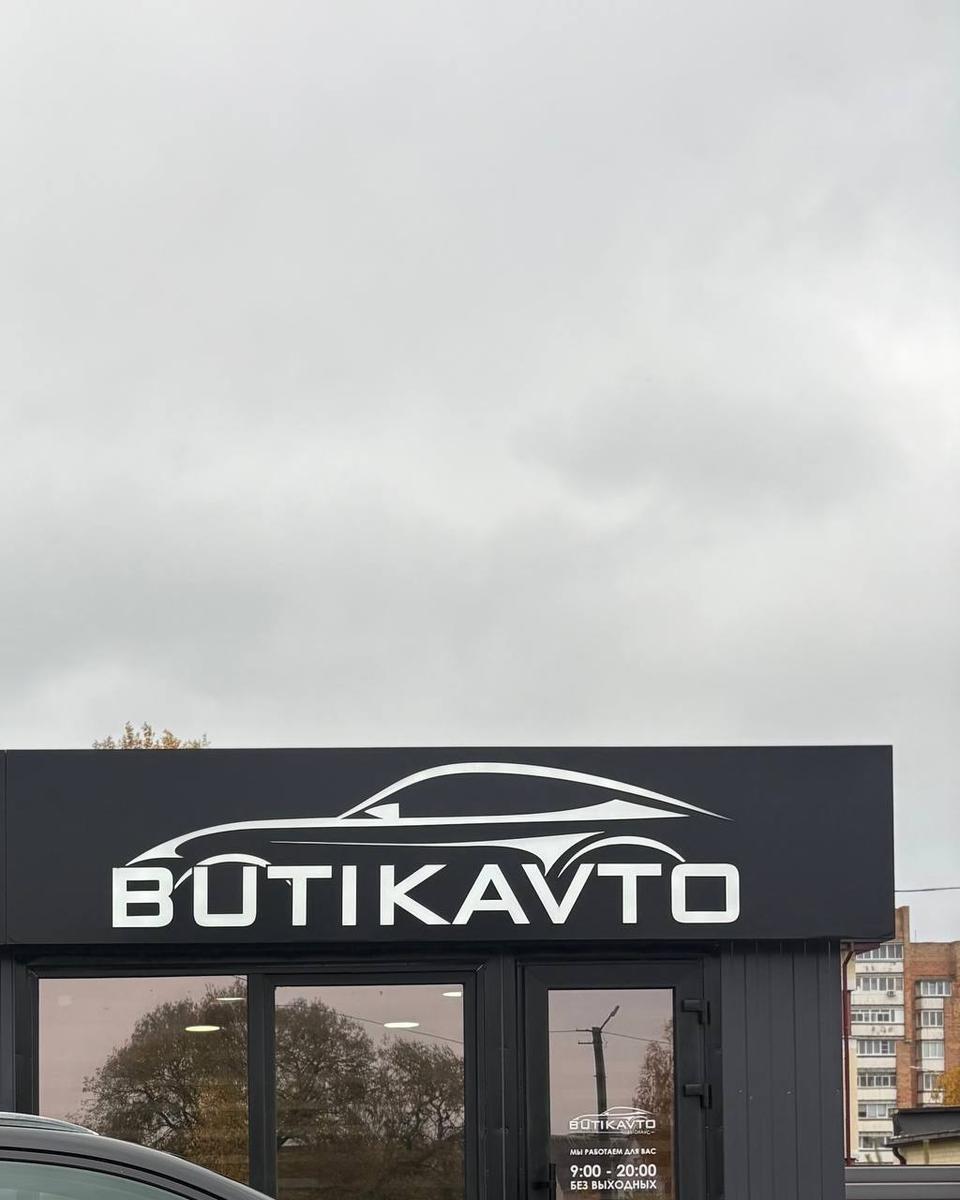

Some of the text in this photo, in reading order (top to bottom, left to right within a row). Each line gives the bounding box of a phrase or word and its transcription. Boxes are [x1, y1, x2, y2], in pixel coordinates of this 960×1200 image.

[112, 863, 740, 928] BUTIKAVTO
[569, 1119, 656, 1130] BUTIKAVTO
[570, 1147, 657, 1156] МЫ РАБОТАЕМ ДЛЯ ВАС
[570, 1164, 601, 1178] 9:00
[616, 1163, 657, 1177] 20:00
[570, 1179, 657, 1191] БЕЗ ВЫХОДНЫХ
